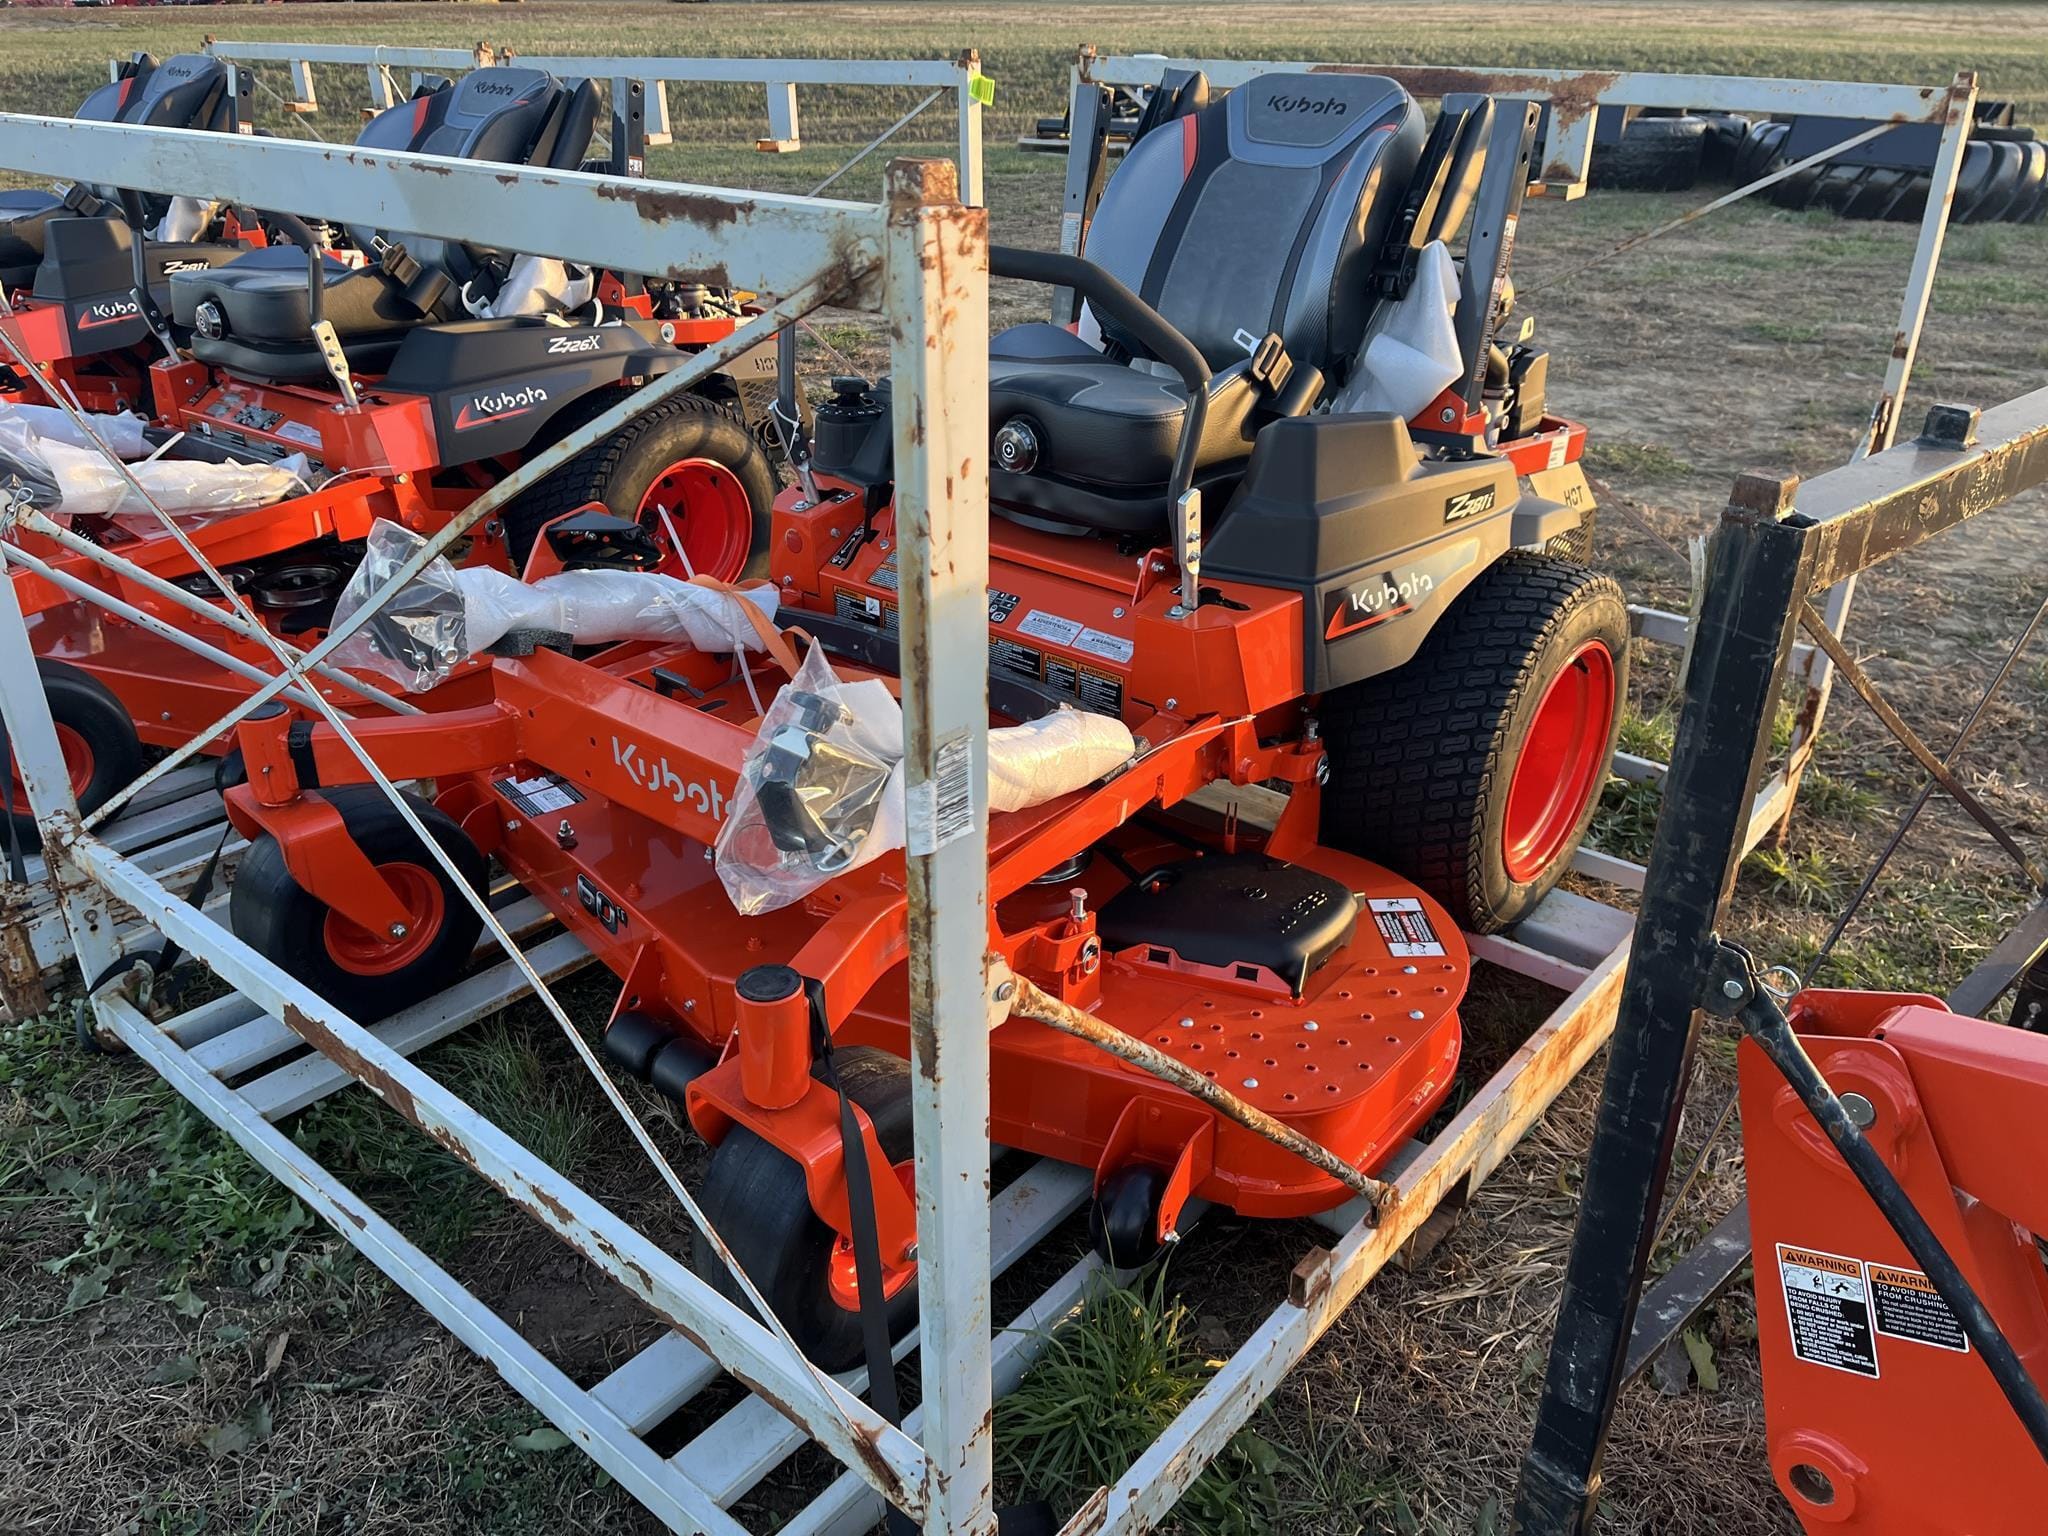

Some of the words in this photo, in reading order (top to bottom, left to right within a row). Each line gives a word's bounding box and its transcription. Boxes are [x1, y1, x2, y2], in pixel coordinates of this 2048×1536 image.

[473, 81, 514, 96] Kubota
[1267, 95, 1348, 115] Kubota
[92, 301, 138, 318] Kubo
[547, 335, 601, 353] Z726X
[474, 386, 548, 413] Kubota
[1563, 485, 1583, 507] HOT
[1351, 571, 1434, 613] Kubota
[1795, 1253, 1857, 1274] WARNING
[1887, 1272, 1934, 1289] WARNI
[1818, 1295, 1841, 1304] INJURY
[1878, 1290, 1901, 1300] FROM
[1904, 1295, 1948, 1309] CRUSHING
[1890, 1286, 1915, 1296] AVOID
[1808, 1299, 1828, 1307] FALLS
